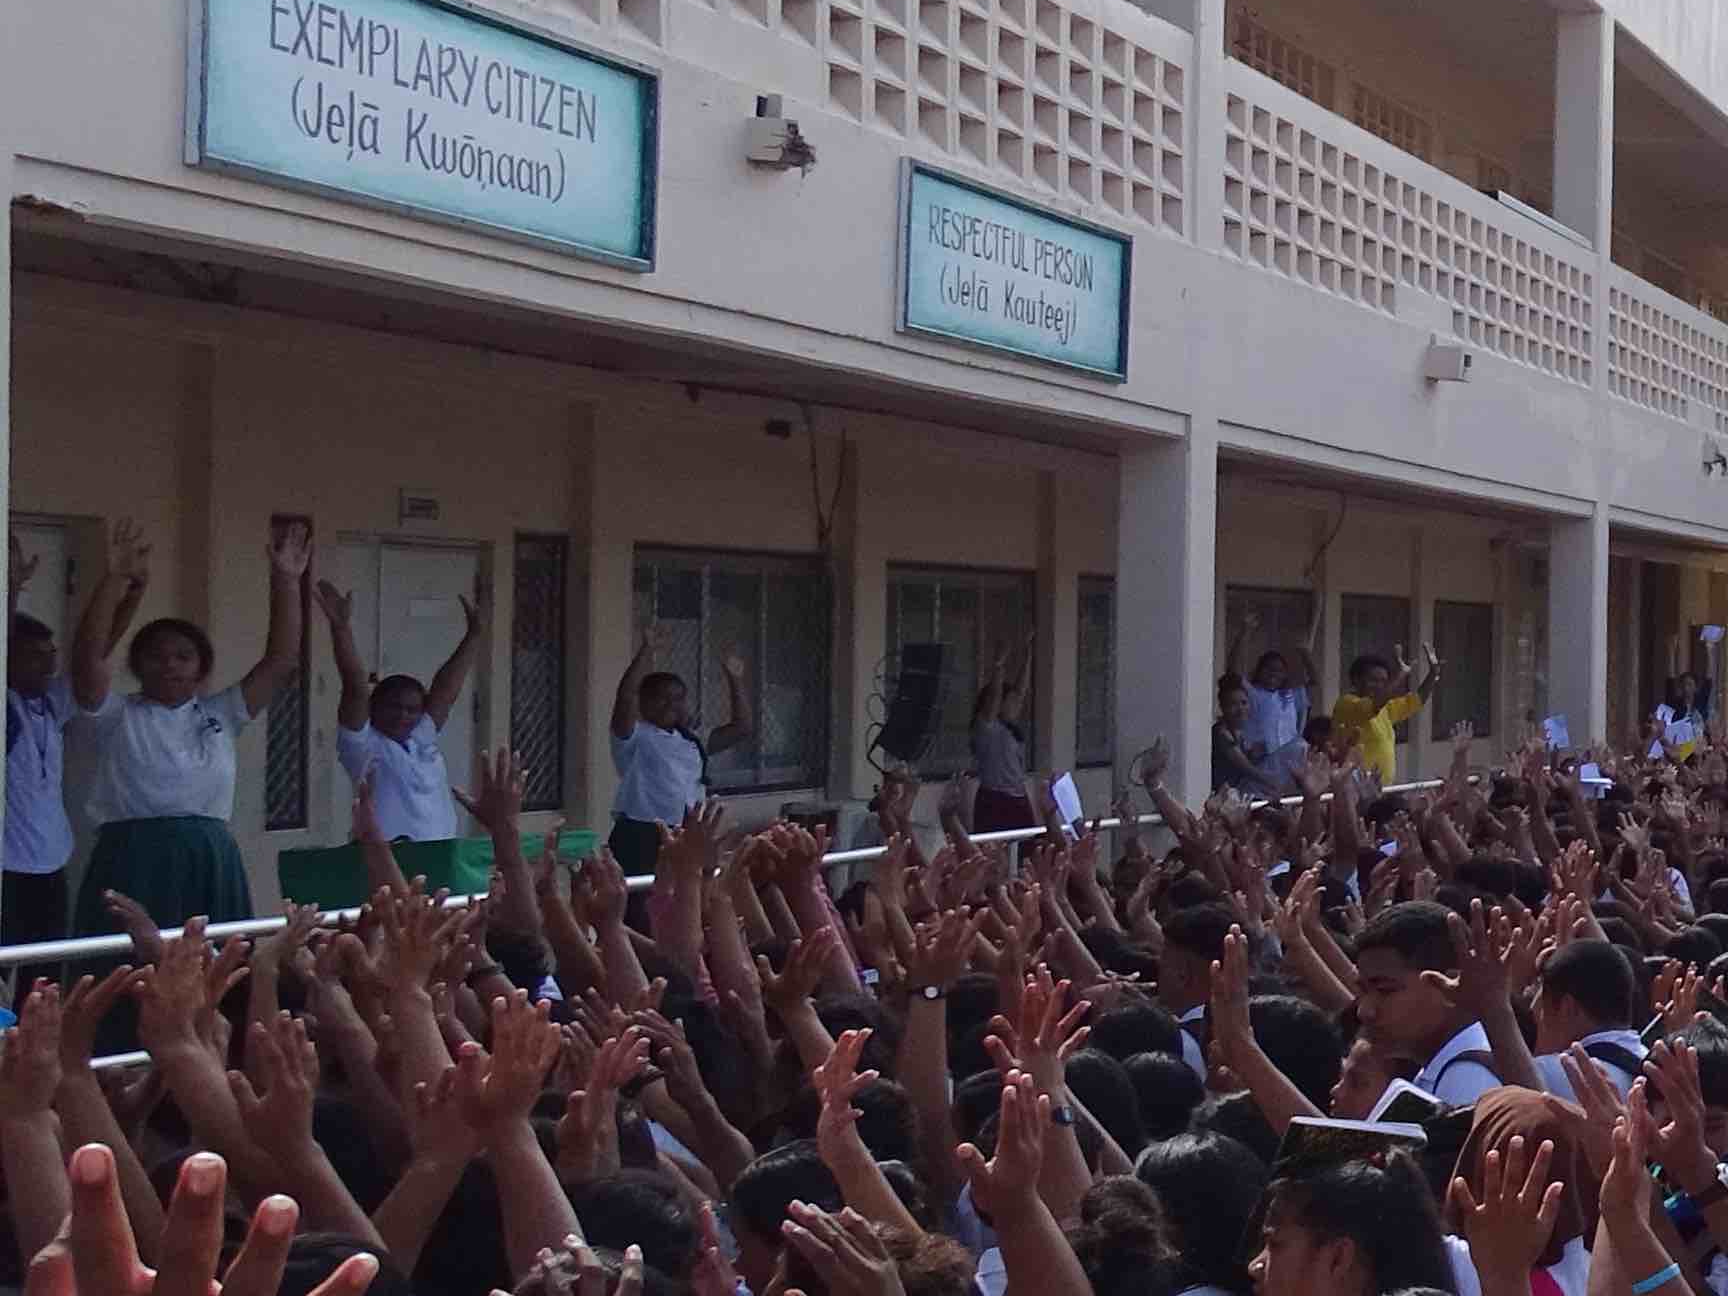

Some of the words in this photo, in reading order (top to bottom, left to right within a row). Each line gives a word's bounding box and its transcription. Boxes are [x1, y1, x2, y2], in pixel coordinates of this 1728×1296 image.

[484, 60, 597, 144] CITIZEN
[928, 204, 1029, 273] RESPECTFUL
[1034, 238, 1094, 293] PERSON
